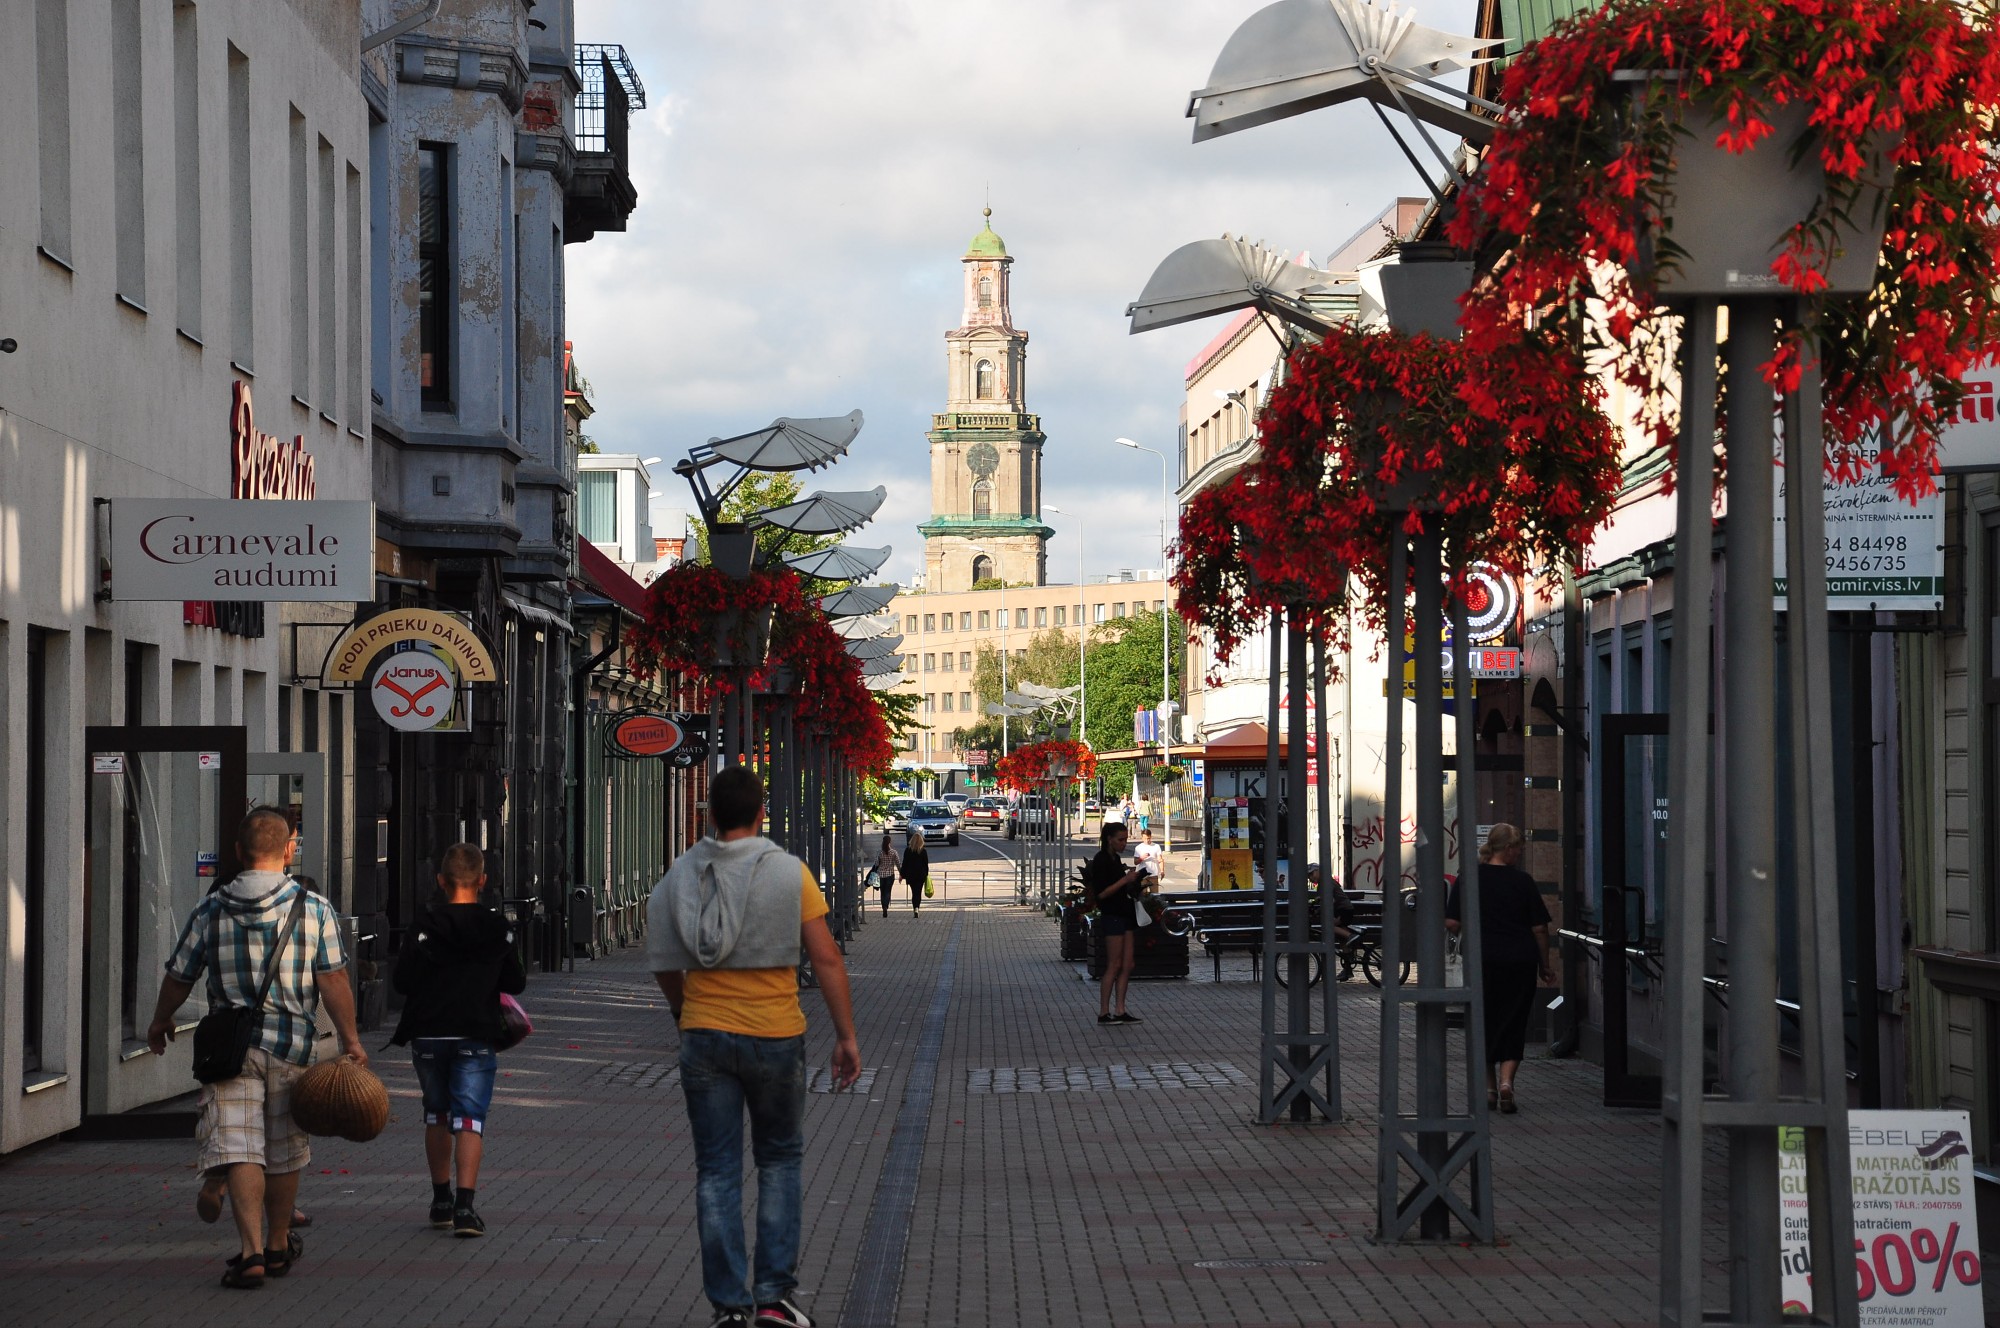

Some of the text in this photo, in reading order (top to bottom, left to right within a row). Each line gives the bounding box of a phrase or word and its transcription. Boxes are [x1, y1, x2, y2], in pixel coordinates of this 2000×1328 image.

[139, 515, 339, 565] Carnevale
[1849, 536, 1907, 551] 84498
[213, 562, 338, 587] audumi
[338, 638, 368, 675] RODI
[368, 618, 427, 642] PRIEKU
[389, 666, 435, 678] Janus
[1852, 1172, 1961, 1195] RAŽOTĀJS
[1922, 1201, 1962, 1210] 20407559
[1900, 1318, 1935, 1326] MATRACI
